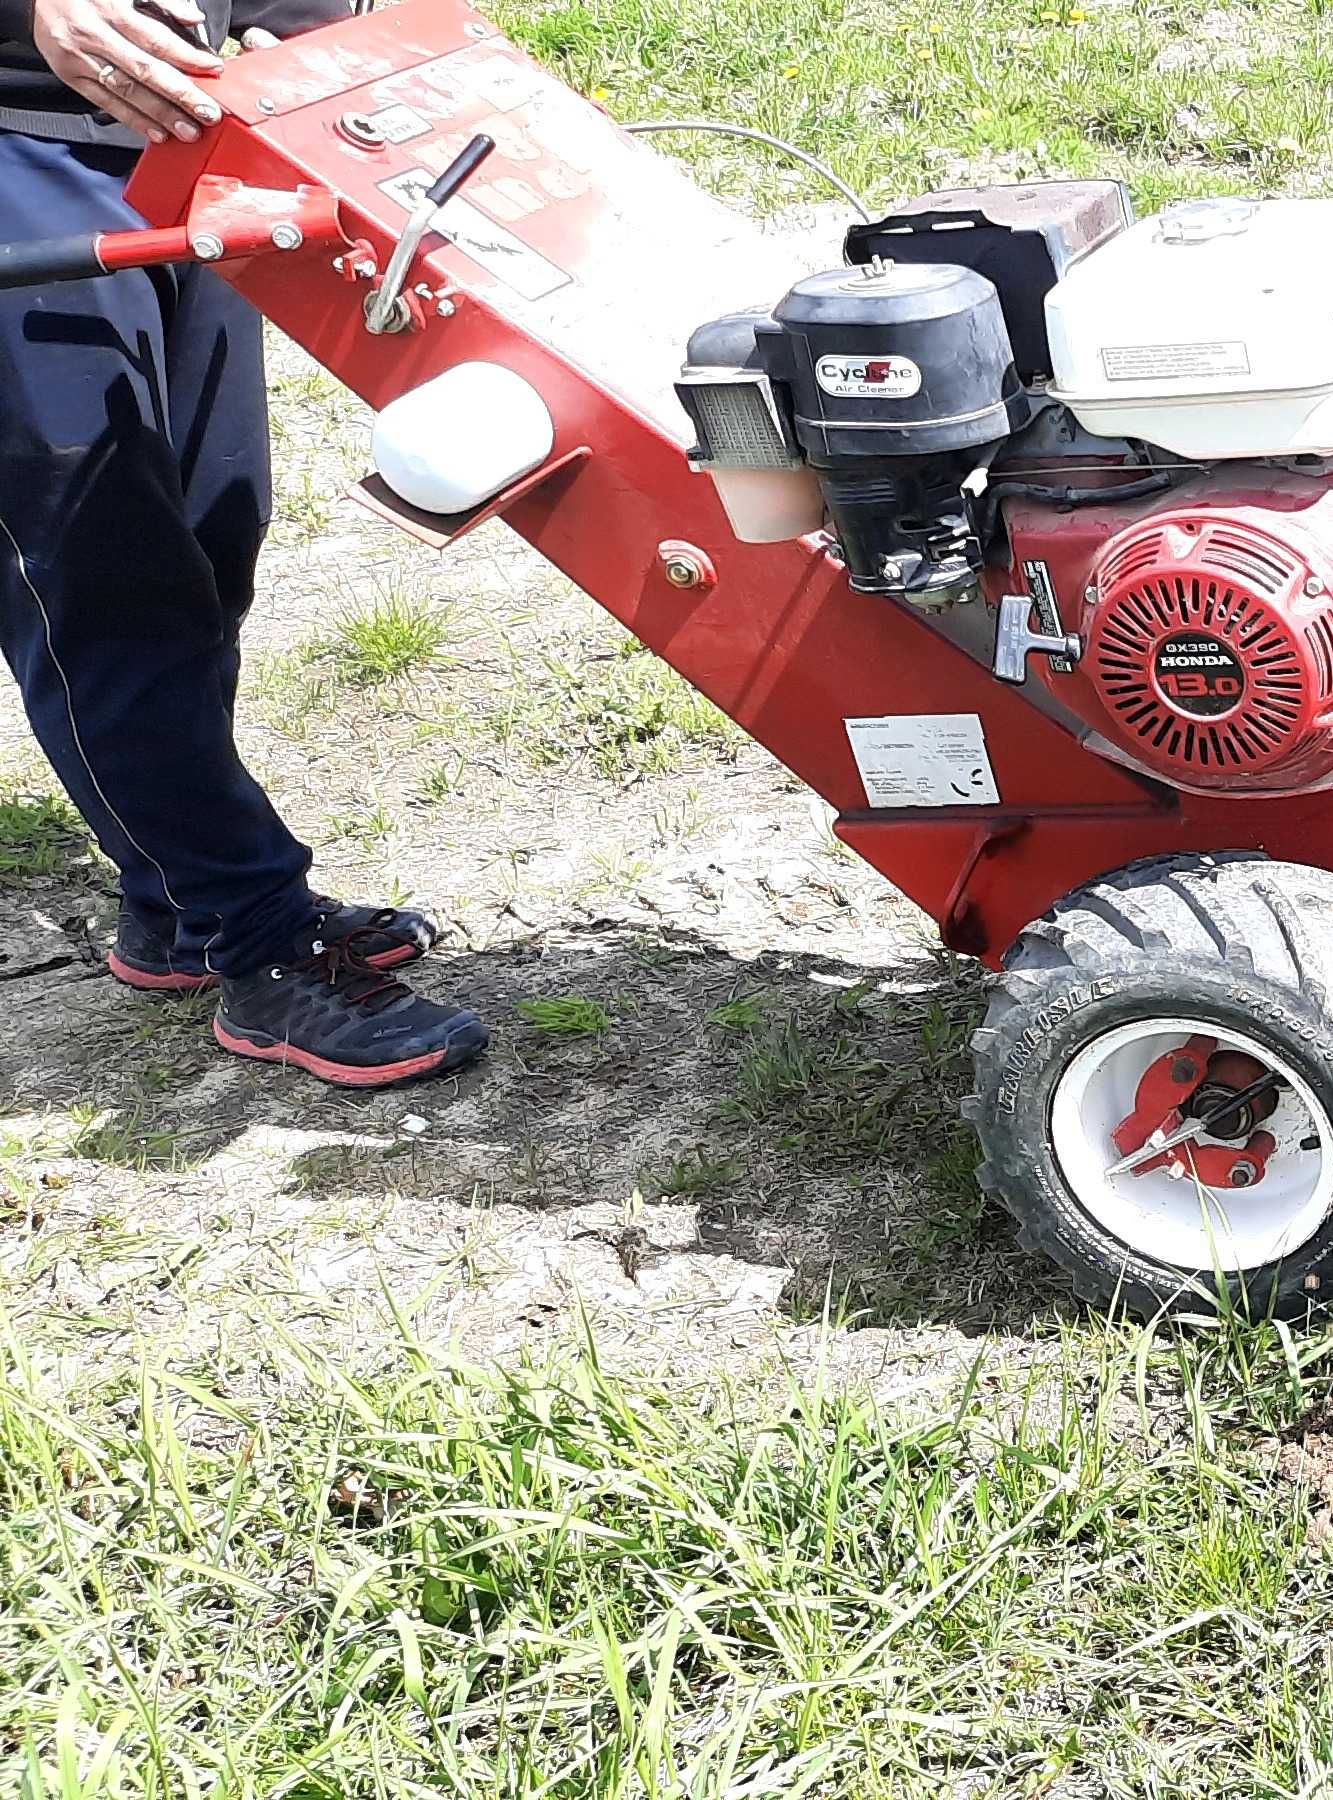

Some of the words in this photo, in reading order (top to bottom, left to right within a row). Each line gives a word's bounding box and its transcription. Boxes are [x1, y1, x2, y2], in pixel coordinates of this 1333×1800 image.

[821, 363, 913, 382] Cyclone
[835, 385, 853, 393] Air
[857, 385, 905, 394] Cleaner
[1165, 642, 1219, 653] GX390
[1160, 655, 1234, 667] HONDA
[1159, 672, 1239, 697] 13.0
[997, 975, 1117, 1115] CARLISLE
